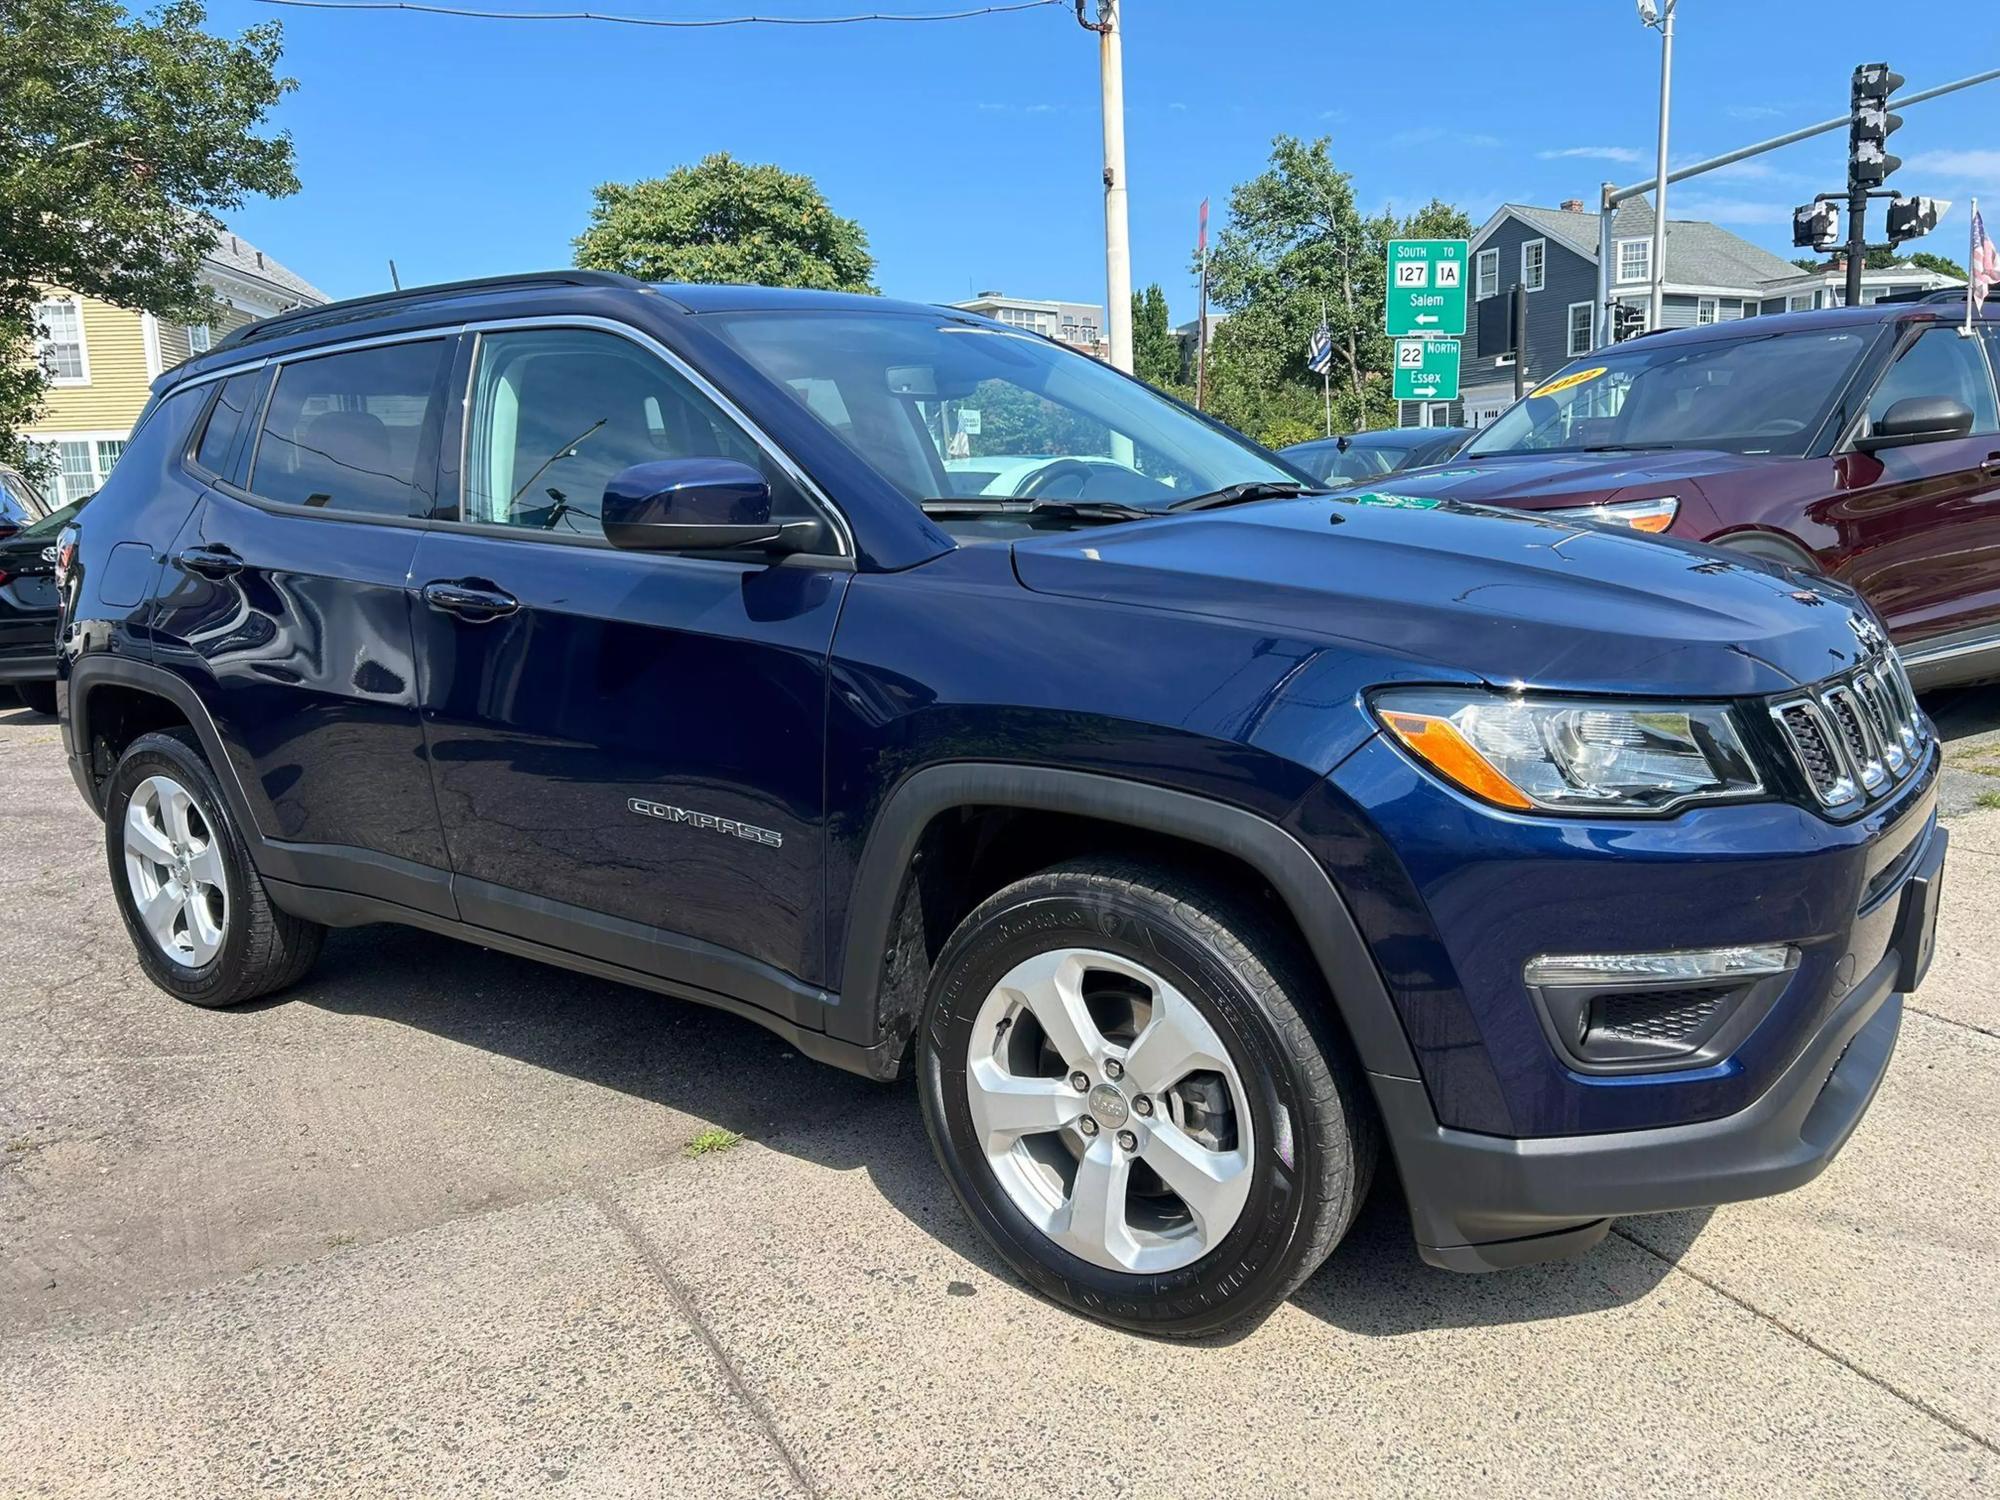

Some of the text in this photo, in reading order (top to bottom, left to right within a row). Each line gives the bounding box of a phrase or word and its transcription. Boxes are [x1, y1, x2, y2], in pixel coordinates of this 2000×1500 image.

[1397, 246, 1455, 258] SOUTH TO
[1399, 267, 1425, 282] 127
[1440, 267, 1456, 282] 1A
[1410, 293, 1444, 307] Salem
[1427, 342, 1457, 354] NORTH
[1401, 348, 1421, 363] 22
[1410, 370, 1441, 384] Essex
[627, 797, 783, 849] COMPASS
